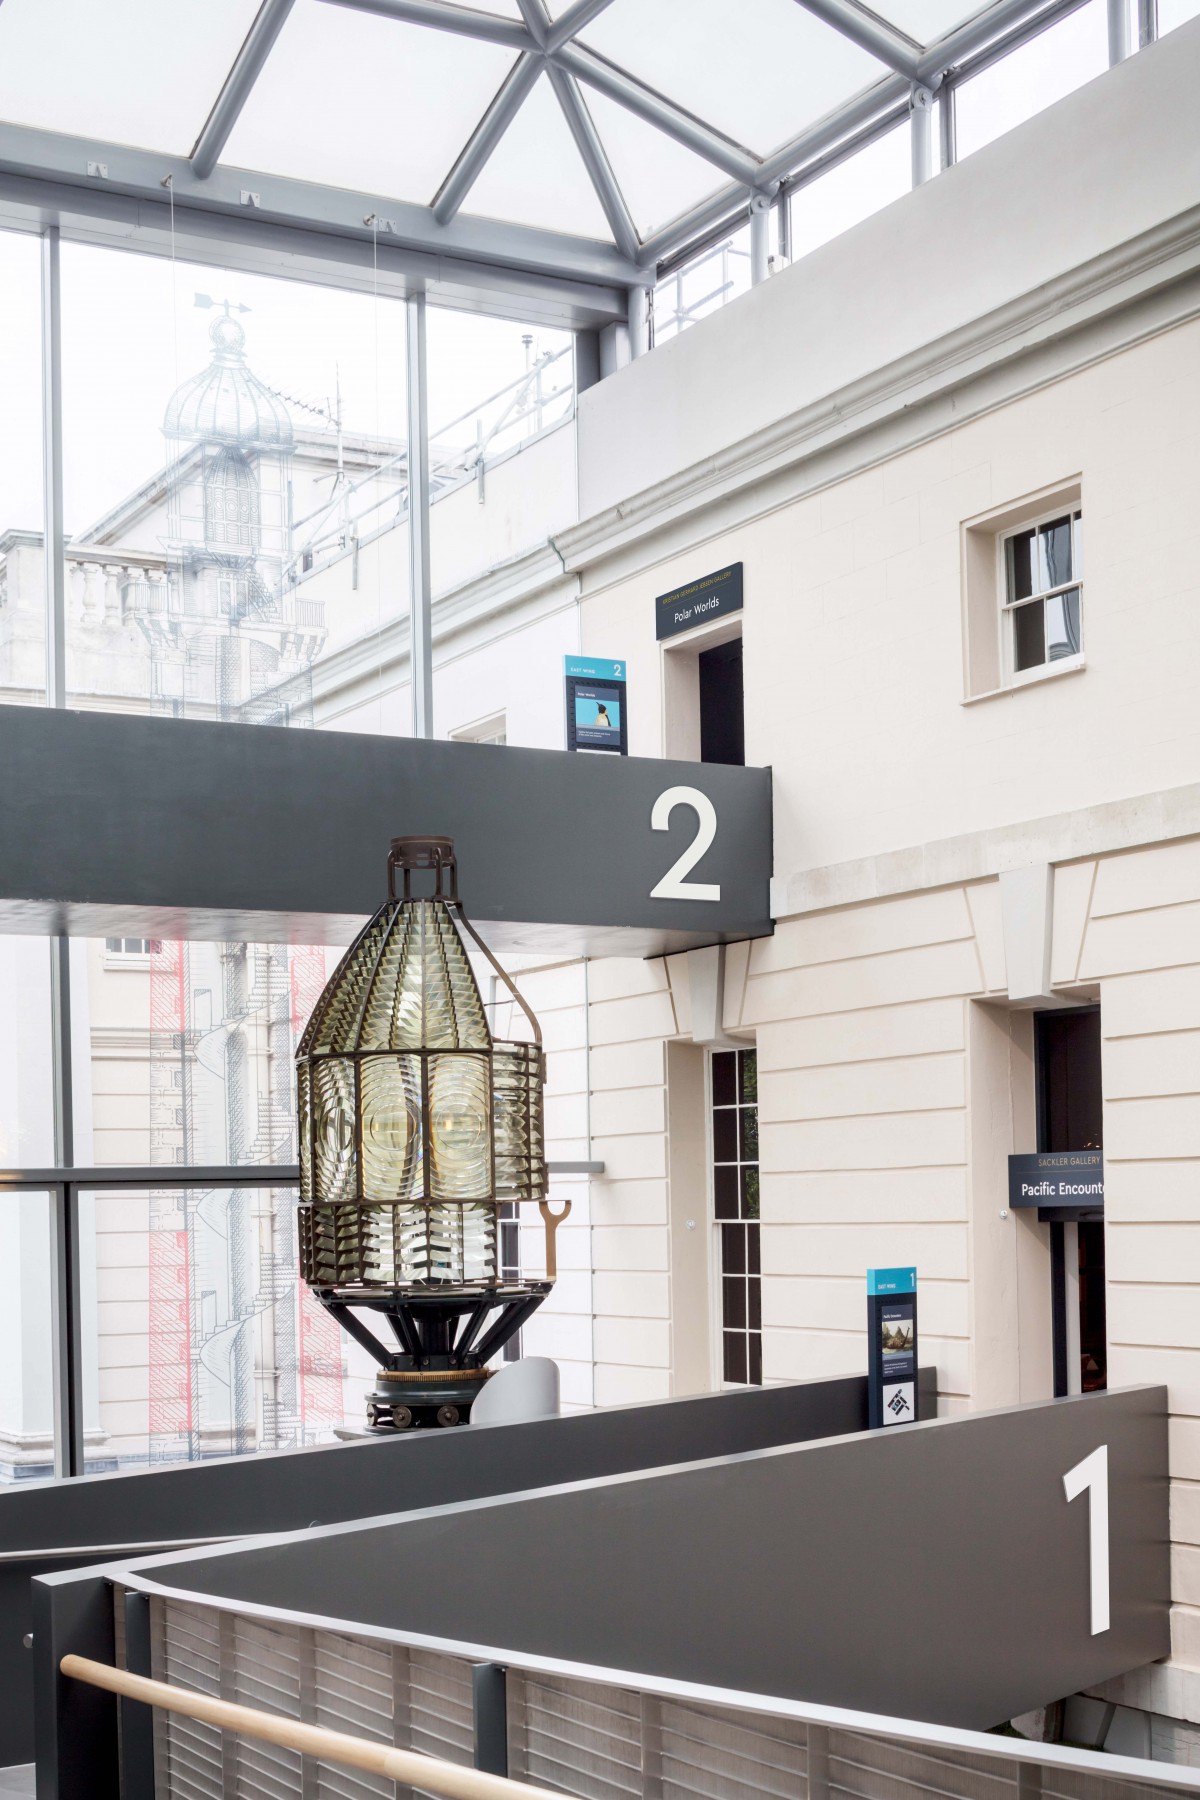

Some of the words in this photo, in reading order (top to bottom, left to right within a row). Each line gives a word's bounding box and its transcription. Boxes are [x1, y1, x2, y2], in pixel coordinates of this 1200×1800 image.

[714, 571, 732, 583] GALLERY
[674, 608, 692, 623] Polar
[694, 596, 719, 614] Worlds
[614, 664, 622, 676] 2
[650, 786, 720, 901] 2
[1038, 1158, 1068, 1166] SACKLER
[1070, 1156, 1100, 1165] GALLERY
[1022, 1182, 1056, 1196] Pacific
[910, 1272, 914, 1287] 1
[1062, 1445, 1110, 1636] 1
